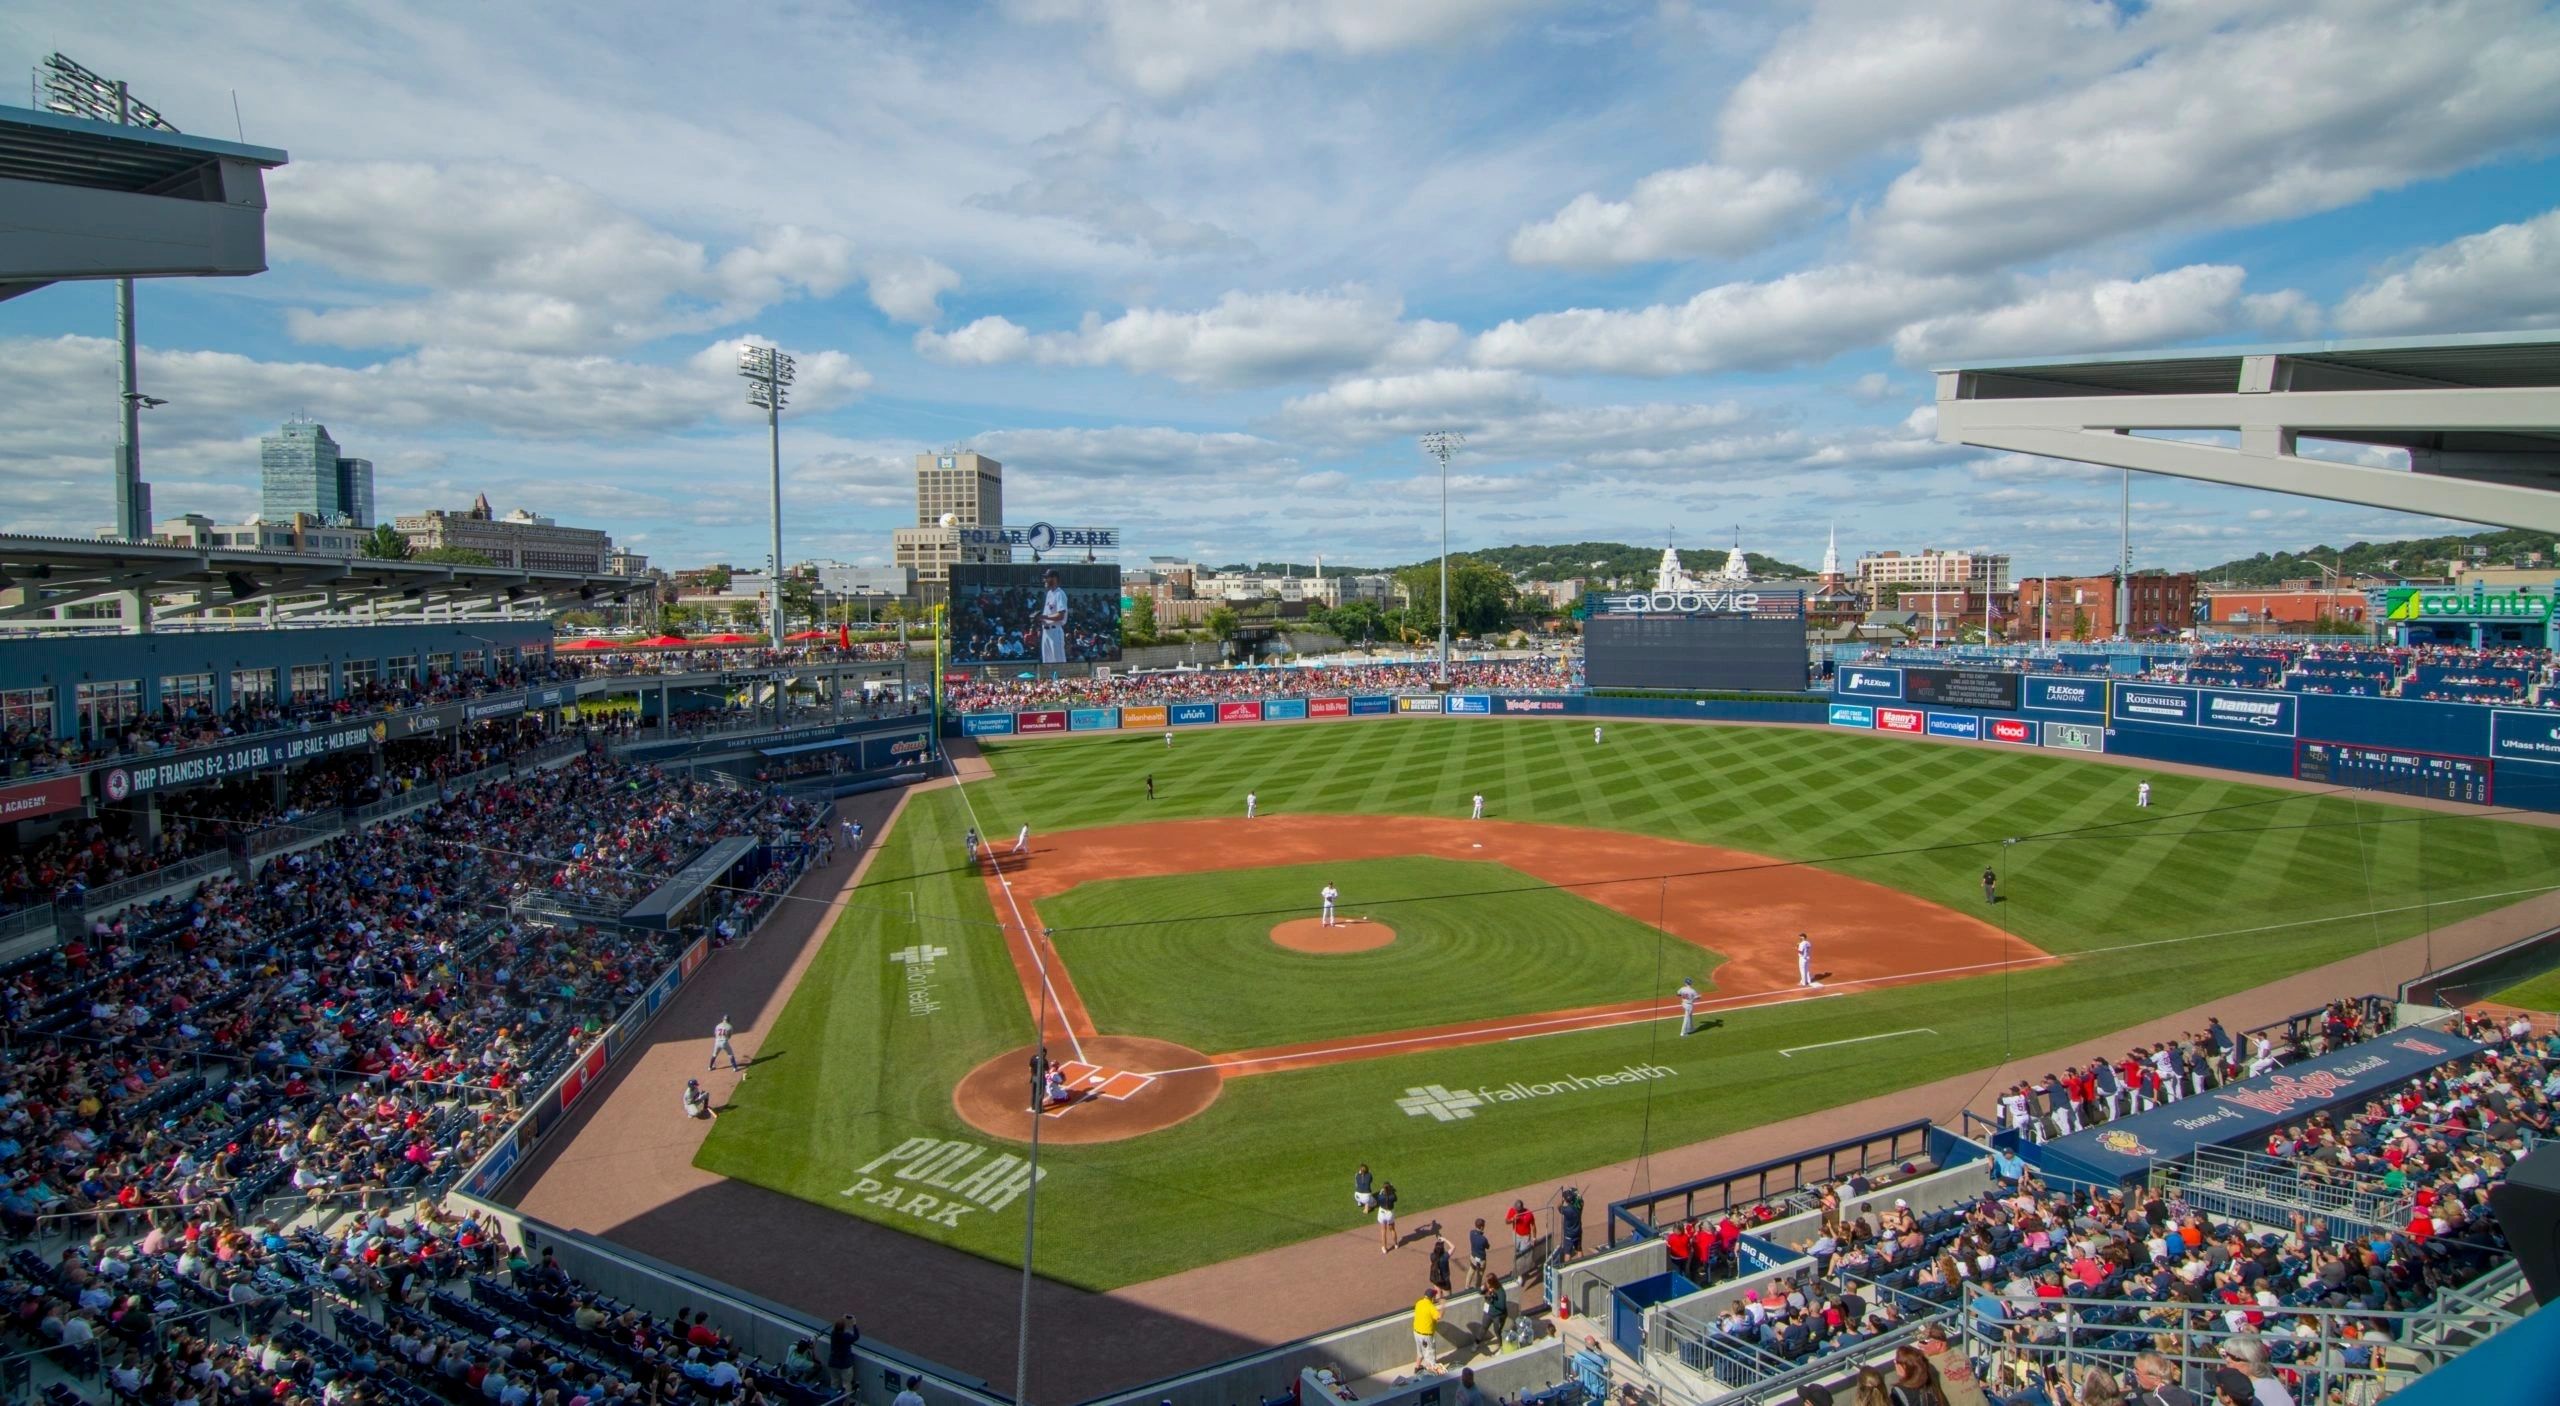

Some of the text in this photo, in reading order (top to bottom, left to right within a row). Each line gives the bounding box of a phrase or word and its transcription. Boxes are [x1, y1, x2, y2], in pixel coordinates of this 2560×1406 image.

[960, 529, 1112, 545] POLAR PARK
[1626, 588, 1760, 612] abbvie
[2423, 590, 2560, 623] country
[2154, 660, 2187, 671] vertikal
[2046, 692, 2084, 702] LANDING
[2125, 692, 2188, 707] RODENHISER
[2210, 697, 2281, 715] Diamond
[1124, 712, 1165, 721] fallonhealth
[1882, 711, 1917, 725] Manny's
[2211, 714, 2247, 722] CHEVROLET
[1930, 719, 1975, 732] nationalgrid
[1996, 726, 2025, 738] Hood
[2105, 728, 2116, 736] 370
[784, 731, 810, 740] BULLPEN
[811, 727, 836, 737] TERRACE
[2502, 739, 2534, 750] UMass
[134, 768, 157, 791] RHP
[160, 759, 205, 786] FRANCIS
[227, 750, 250, 772] 3.04
[250, 746, 270, 767] ERA
[288, 740, 303, 758] LHP
[304, 736, 325, 755] SALE
[328, 731, 345, 750] MLB
[345, 727, 369, 746] REHAB
[2365, 752, 2381, 760] BALL
[2380, 753, 2387, 762] 0
[2391, 755, 2413, 765] STRIKE
[2412, 756, 2419, 766] 0
[2430, 760, 2443, 768] OUT
[2444, 760, 2452, 770] 0
[2455, 762, 2471, 771] MPH
[2449, 781, 2456, 789] 0
[2466, 783, 2472, 791] 0
[2449, 789, 2455, 797] 0
[2478, 793, 2484, 801] 0
[5, 795, 47, 814] ACADEMY
[2173, 1055, 2390, 1130] Home of WooSox Baseball
[853, 1137, 1048, 1214] POLAR
[840, 1177, 977, 1228] PARK
[1741, 1242, 1757, 1257] BIG
